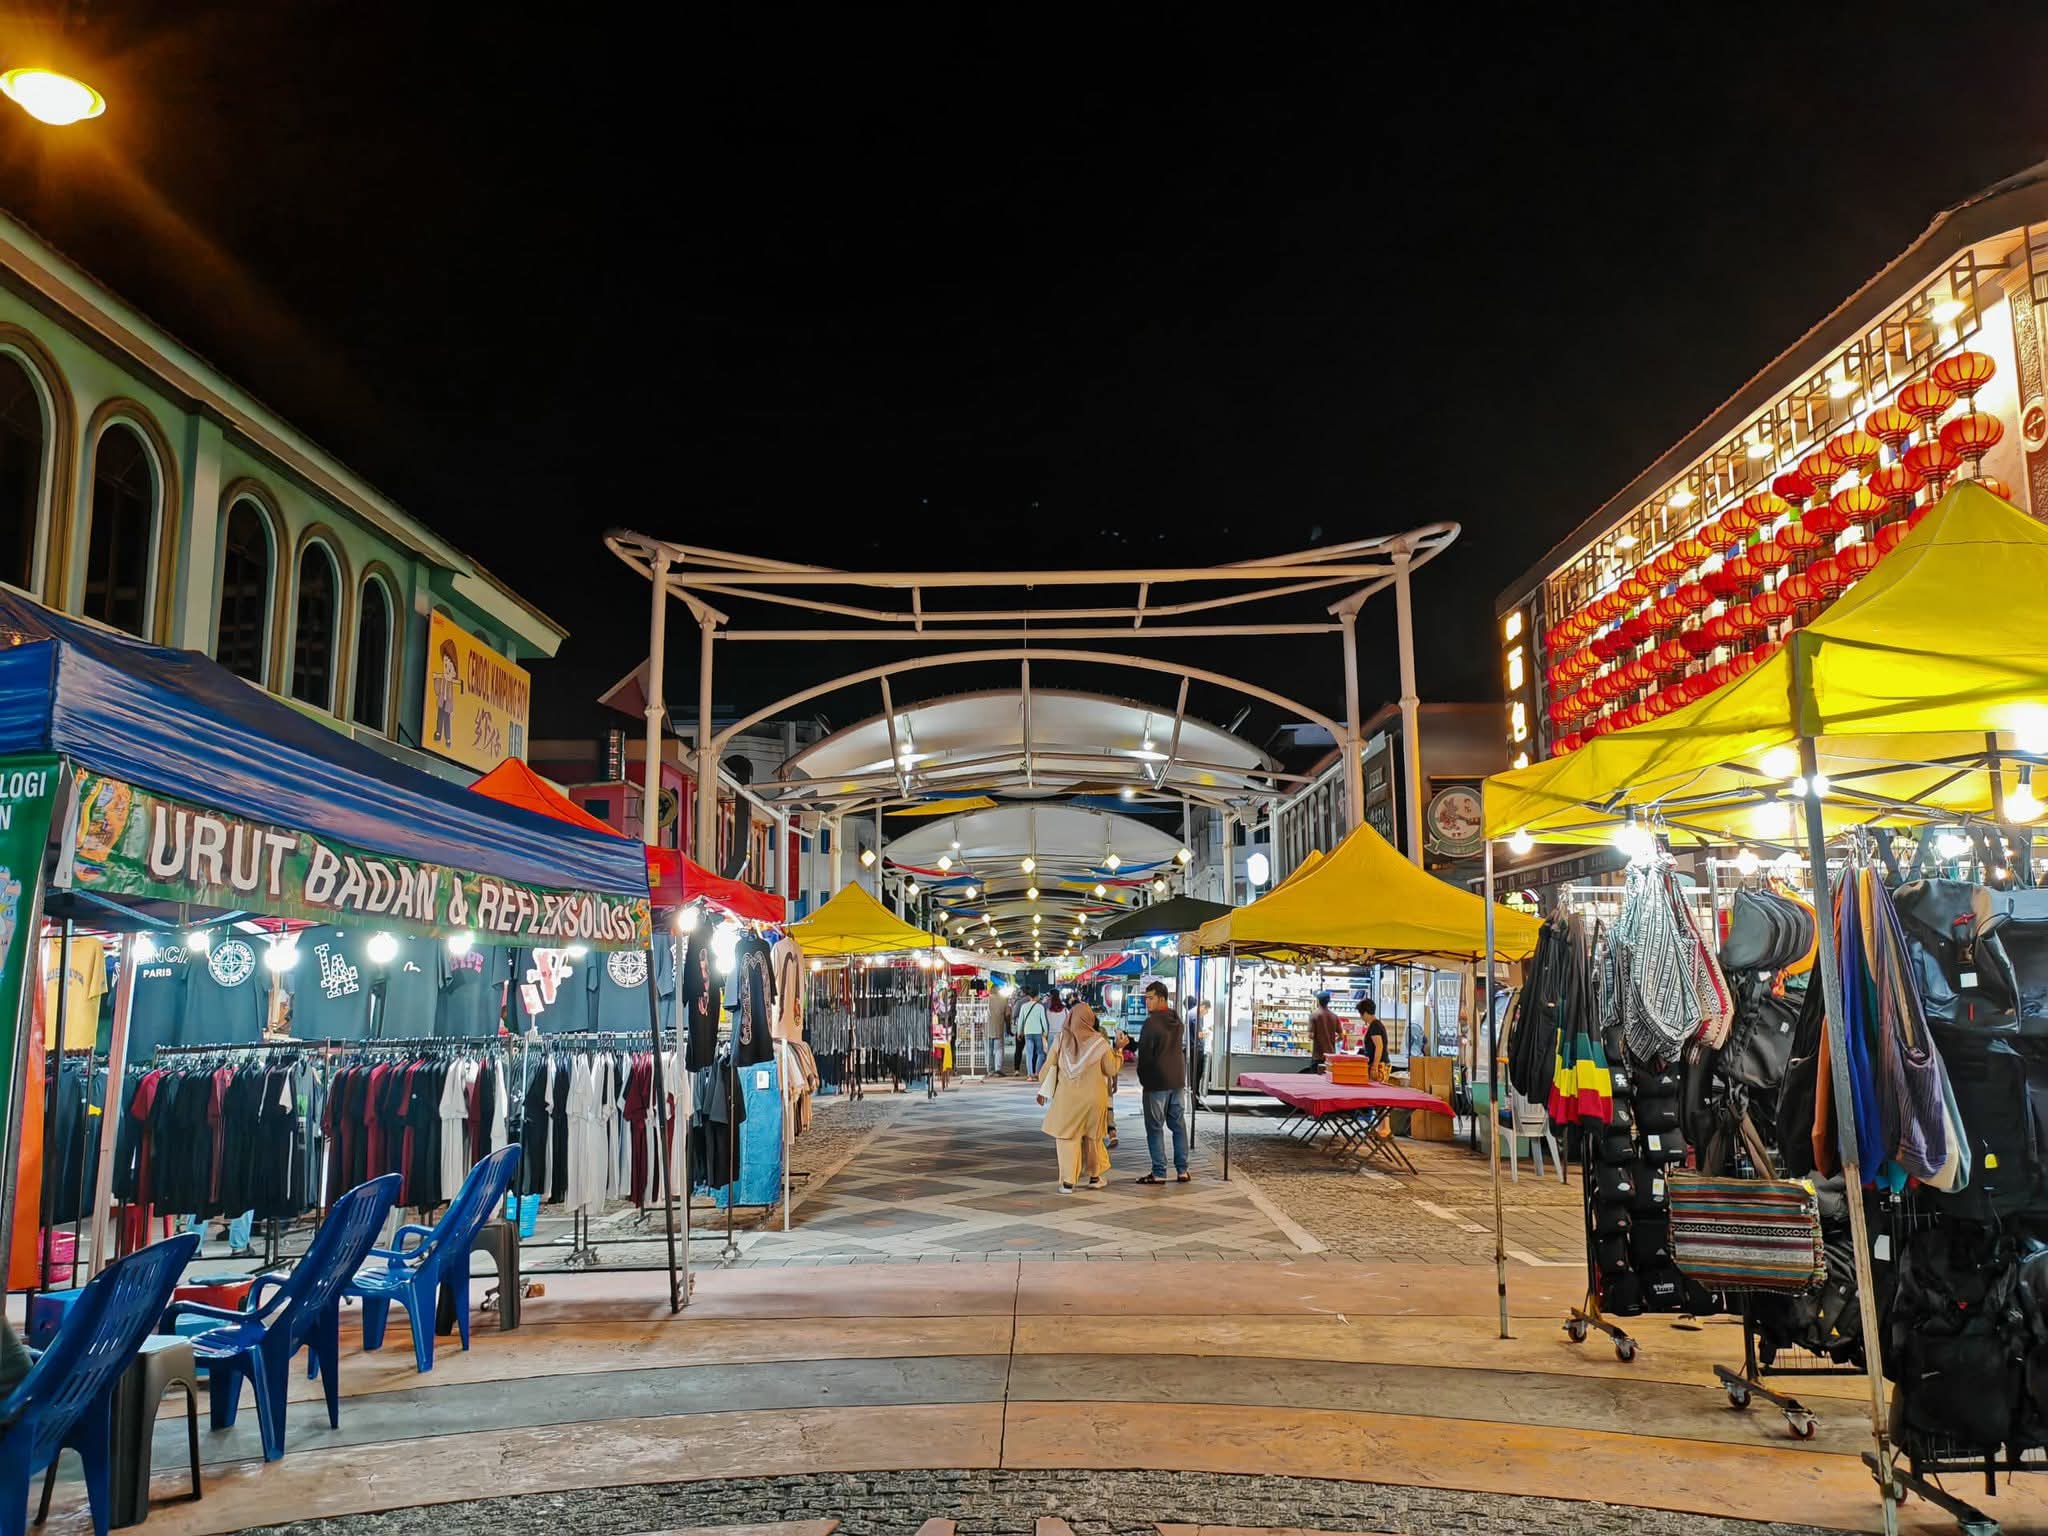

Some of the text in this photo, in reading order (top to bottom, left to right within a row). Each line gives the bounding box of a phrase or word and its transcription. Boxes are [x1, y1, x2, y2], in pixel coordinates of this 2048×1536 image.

[0, 771, 47, 798] LOGI
[151, 806, 297, 895] URUT
[304, 844, 439, 921] BADAN
[448, 877, 469, 926] &
